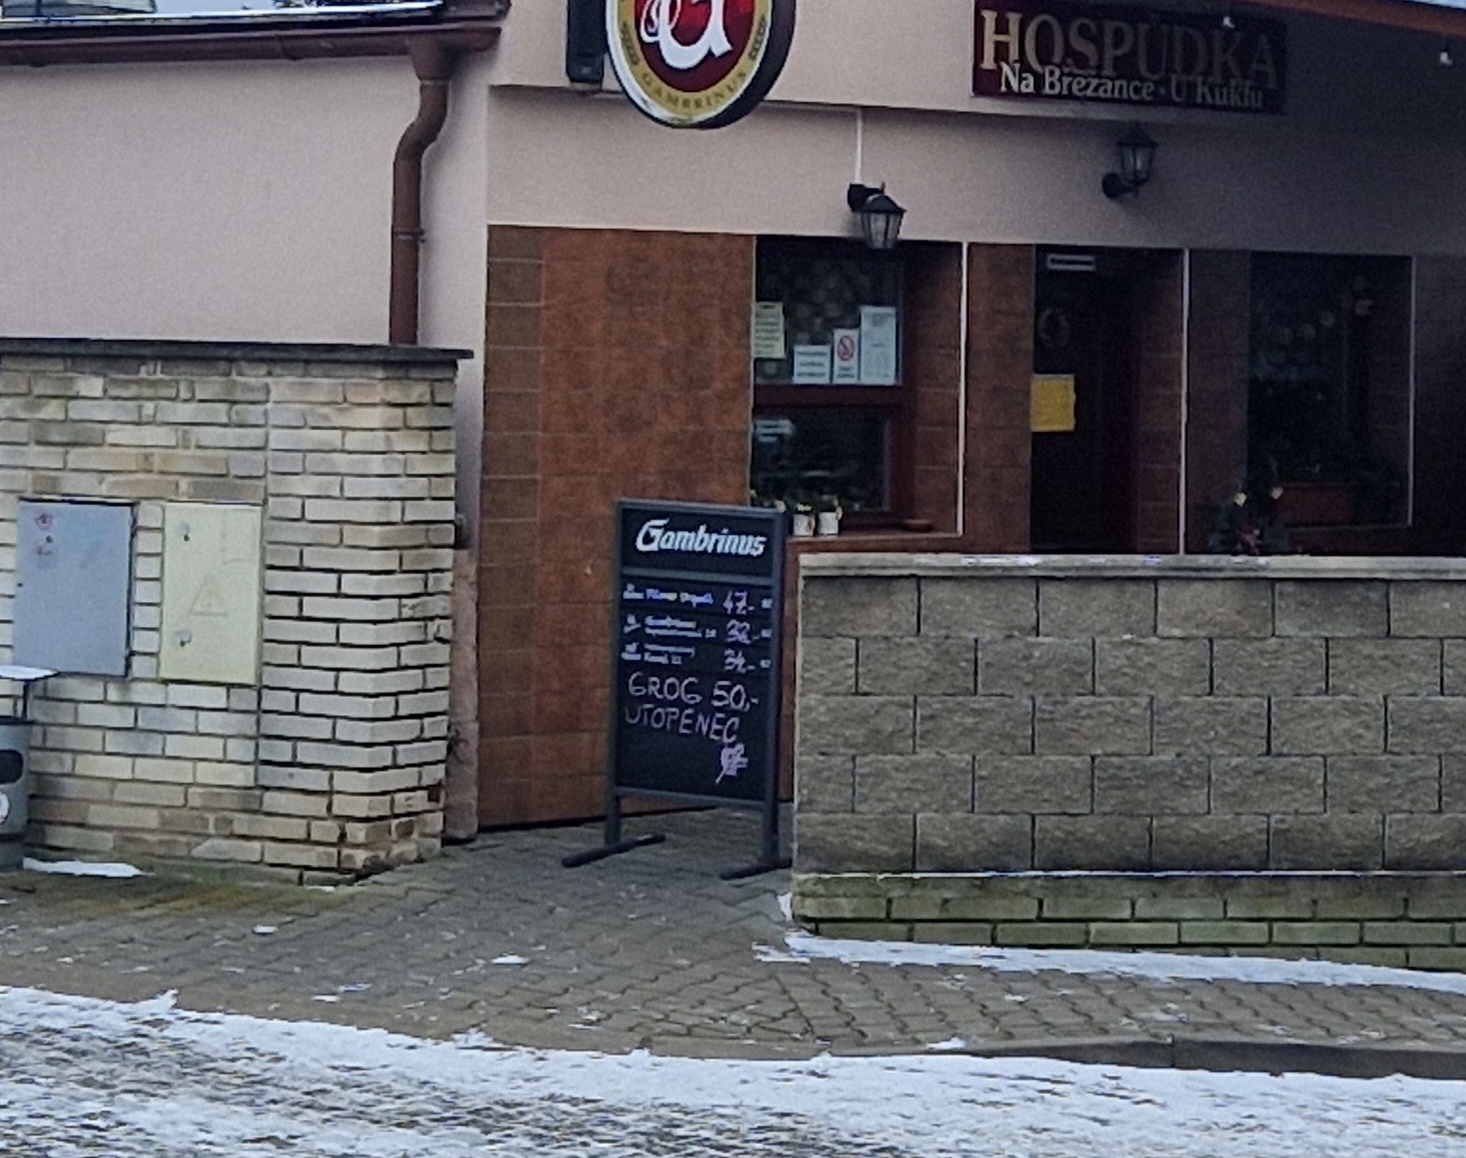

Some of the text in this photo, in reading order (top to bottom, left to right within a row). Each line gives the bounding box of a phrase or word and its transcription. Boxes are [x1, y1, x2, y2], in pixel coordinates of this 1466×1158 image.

[999, 61, 1036, 94] Na
[635, 518, 767, 557] Gambrinus
[628, 670, 703, 705] GROG
[624, 703, 740, 743] UTOPENEC
